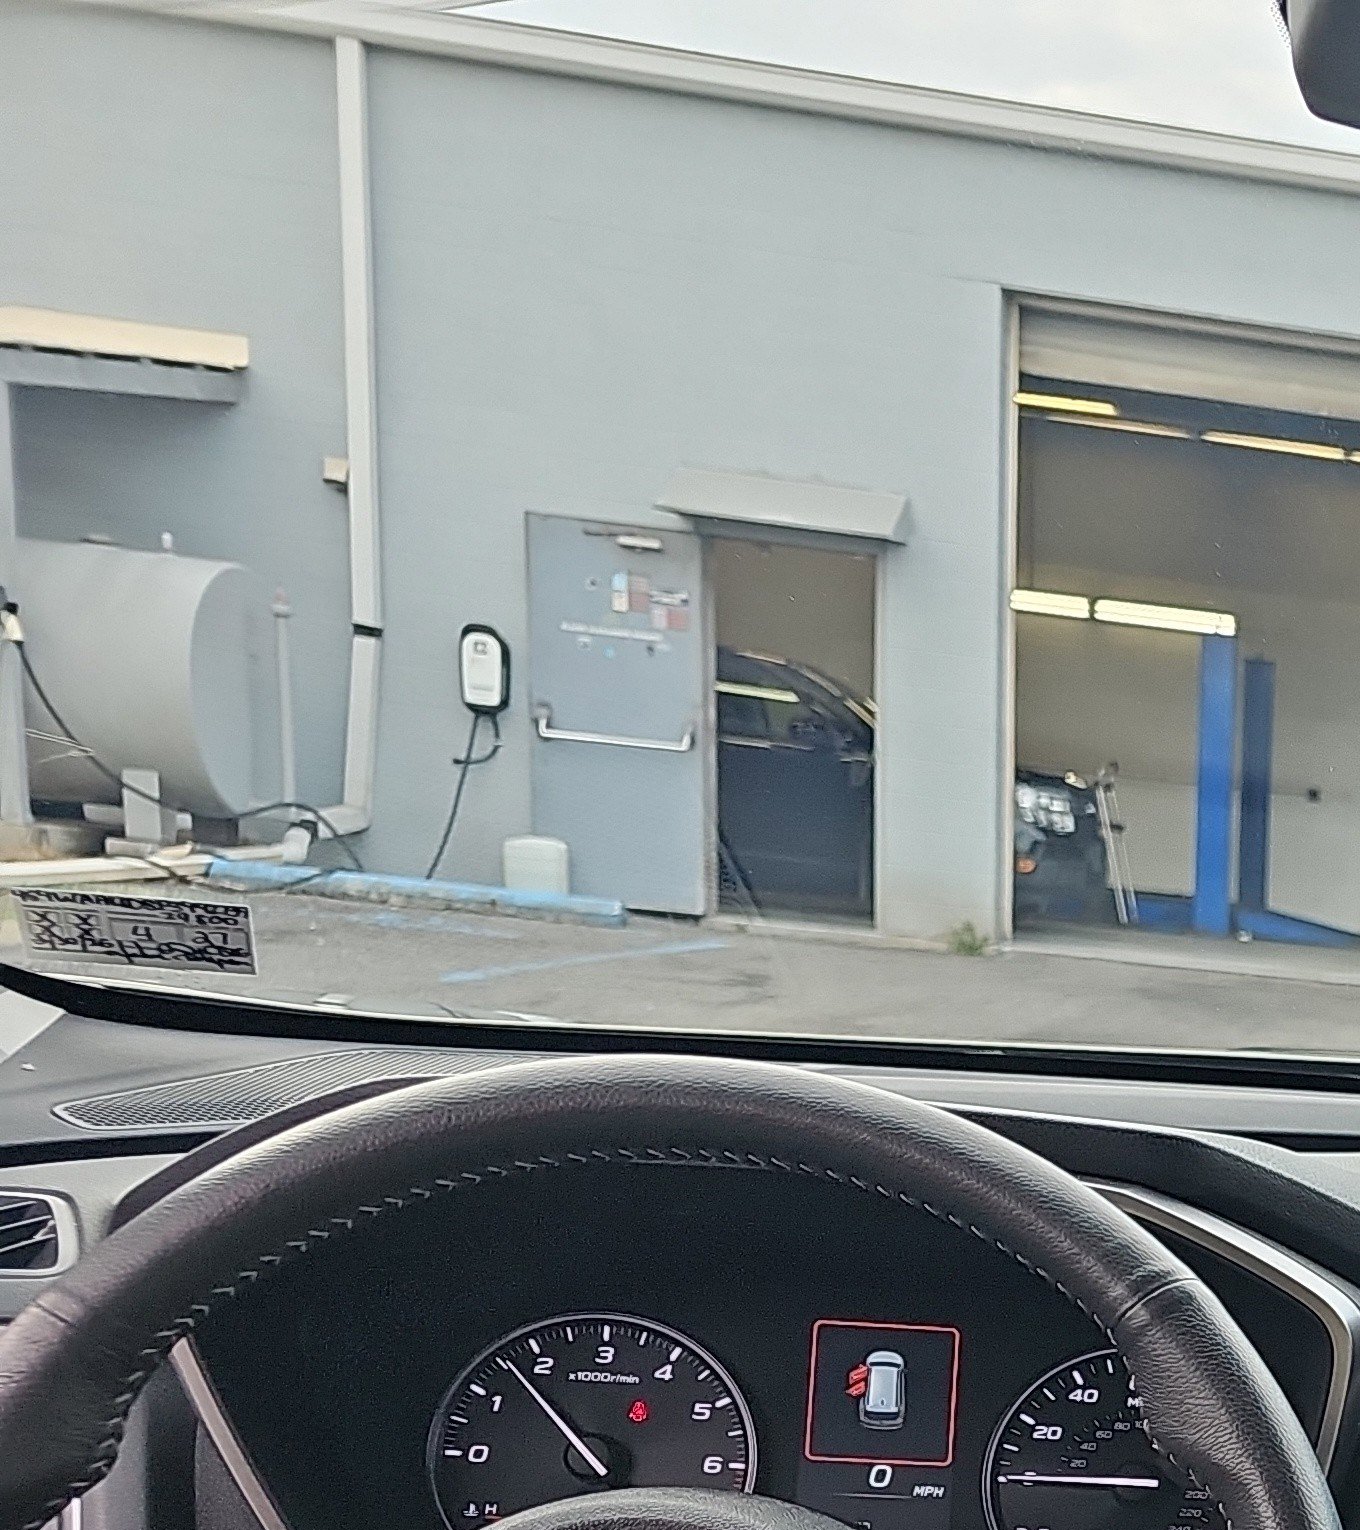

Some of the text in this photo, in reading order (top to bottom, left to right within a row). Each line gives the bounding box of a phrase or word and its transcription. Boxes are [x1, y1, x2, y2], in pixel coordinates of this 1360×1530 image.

[595, 1347, 614, 1363] 3
[534, 1358, 553, 1374] 2
[654, 1364, 673, 1381] 4
[568, 1370, 640, 1384] x1000r/min
[491, 1395, 502, 1412] 1
[1069, 1389, 1098, 1403] 40
[692, 1403, 712, 1420] 5
[1033, 1426, 1062, 1440] 20
[1114, 1422, 1130, 1430] 80
[1096, 1431, 1112, 1439] 60
[468, 1445, 489, 1462] 0
[703, 1457, 722, 1473] 6
[1070, 1459, 1086, 1468] 20
[869, 1464, 893, 1488] 0
[912, 1486, 944, 1498] MPH
[484, 1503, 497, 1515] H
